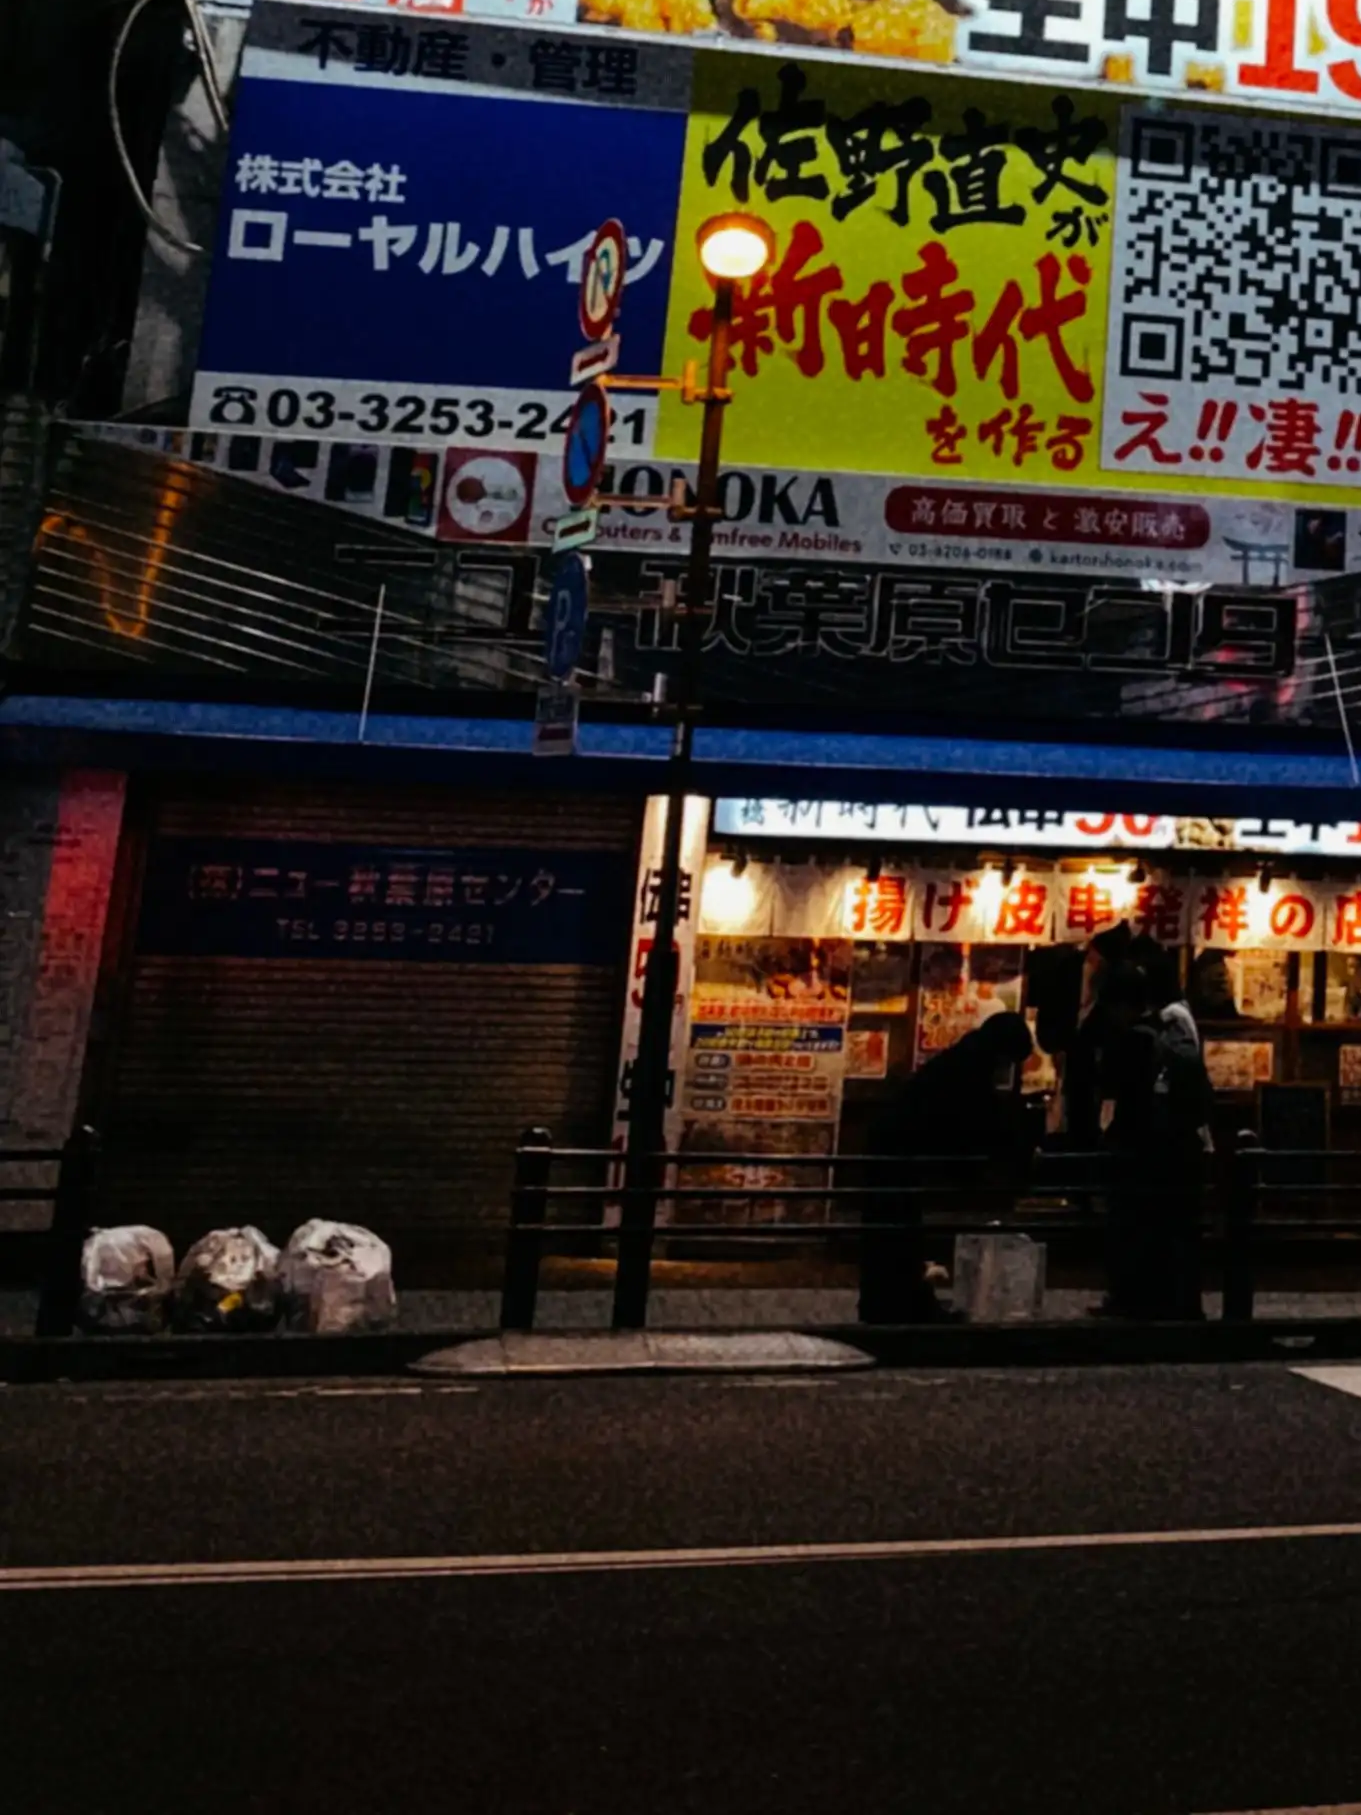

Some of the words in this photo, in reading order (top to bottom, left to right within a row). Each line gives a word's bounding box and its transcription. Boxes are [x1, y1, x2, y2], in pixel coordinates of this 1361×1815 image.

[299, 18, 639, 96] 不動産・管理
[235, 153, 408, 204] 株式会社
[777, 530, 862, 555] Mobiles
